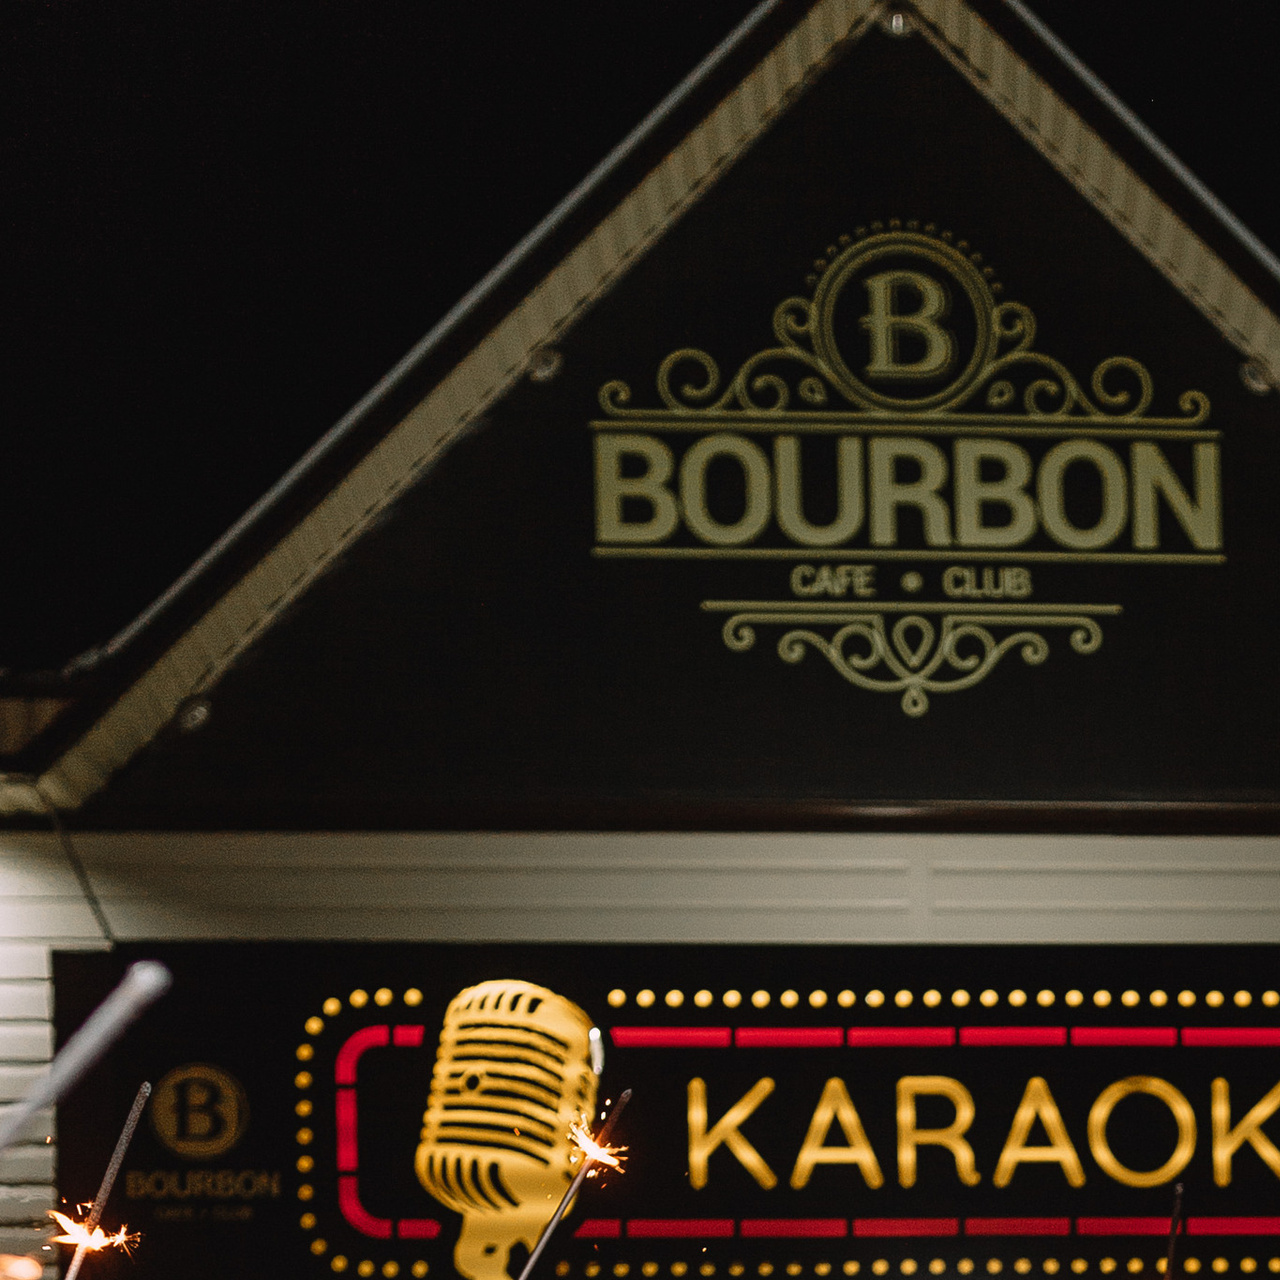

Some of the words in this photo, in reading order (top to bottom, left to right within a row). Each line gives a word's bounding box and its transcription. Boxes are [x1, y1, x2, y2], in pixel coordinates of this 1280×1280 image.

[863, 270, 953, 377] B
[594, 433, 1222, 550] BOURBON
[790, 564, 876, 598] CAFE
[942, 565, 1032, 599] CLUB
[126, 1169, 282, 1198] BOURBON
